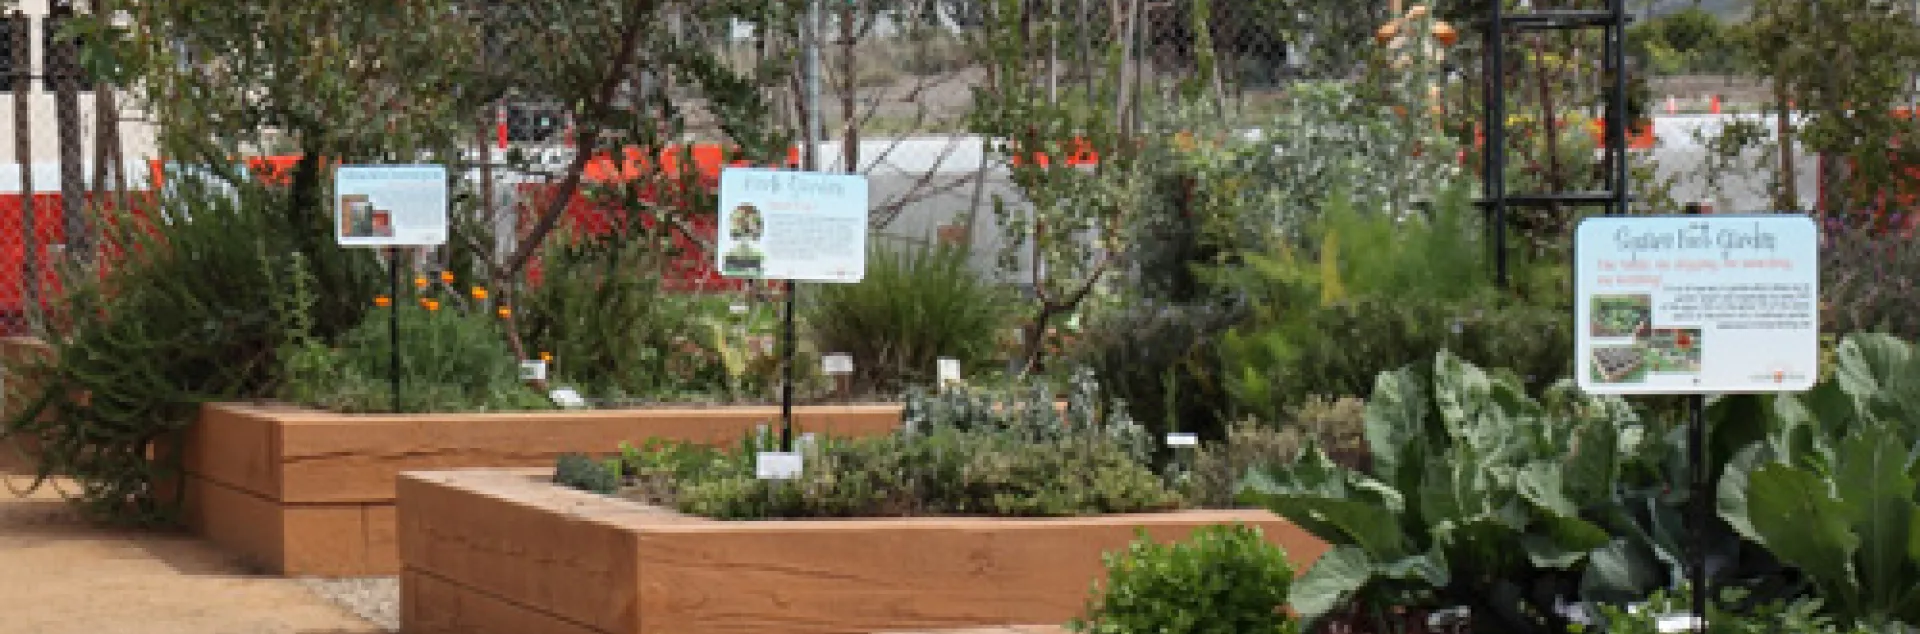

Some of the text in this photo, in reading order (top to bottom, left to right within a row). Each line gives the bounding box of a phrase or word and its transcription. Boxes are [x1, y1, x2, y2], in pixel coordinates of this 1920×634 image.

[1613, 221, 1776, 261] Square Foot Garden
